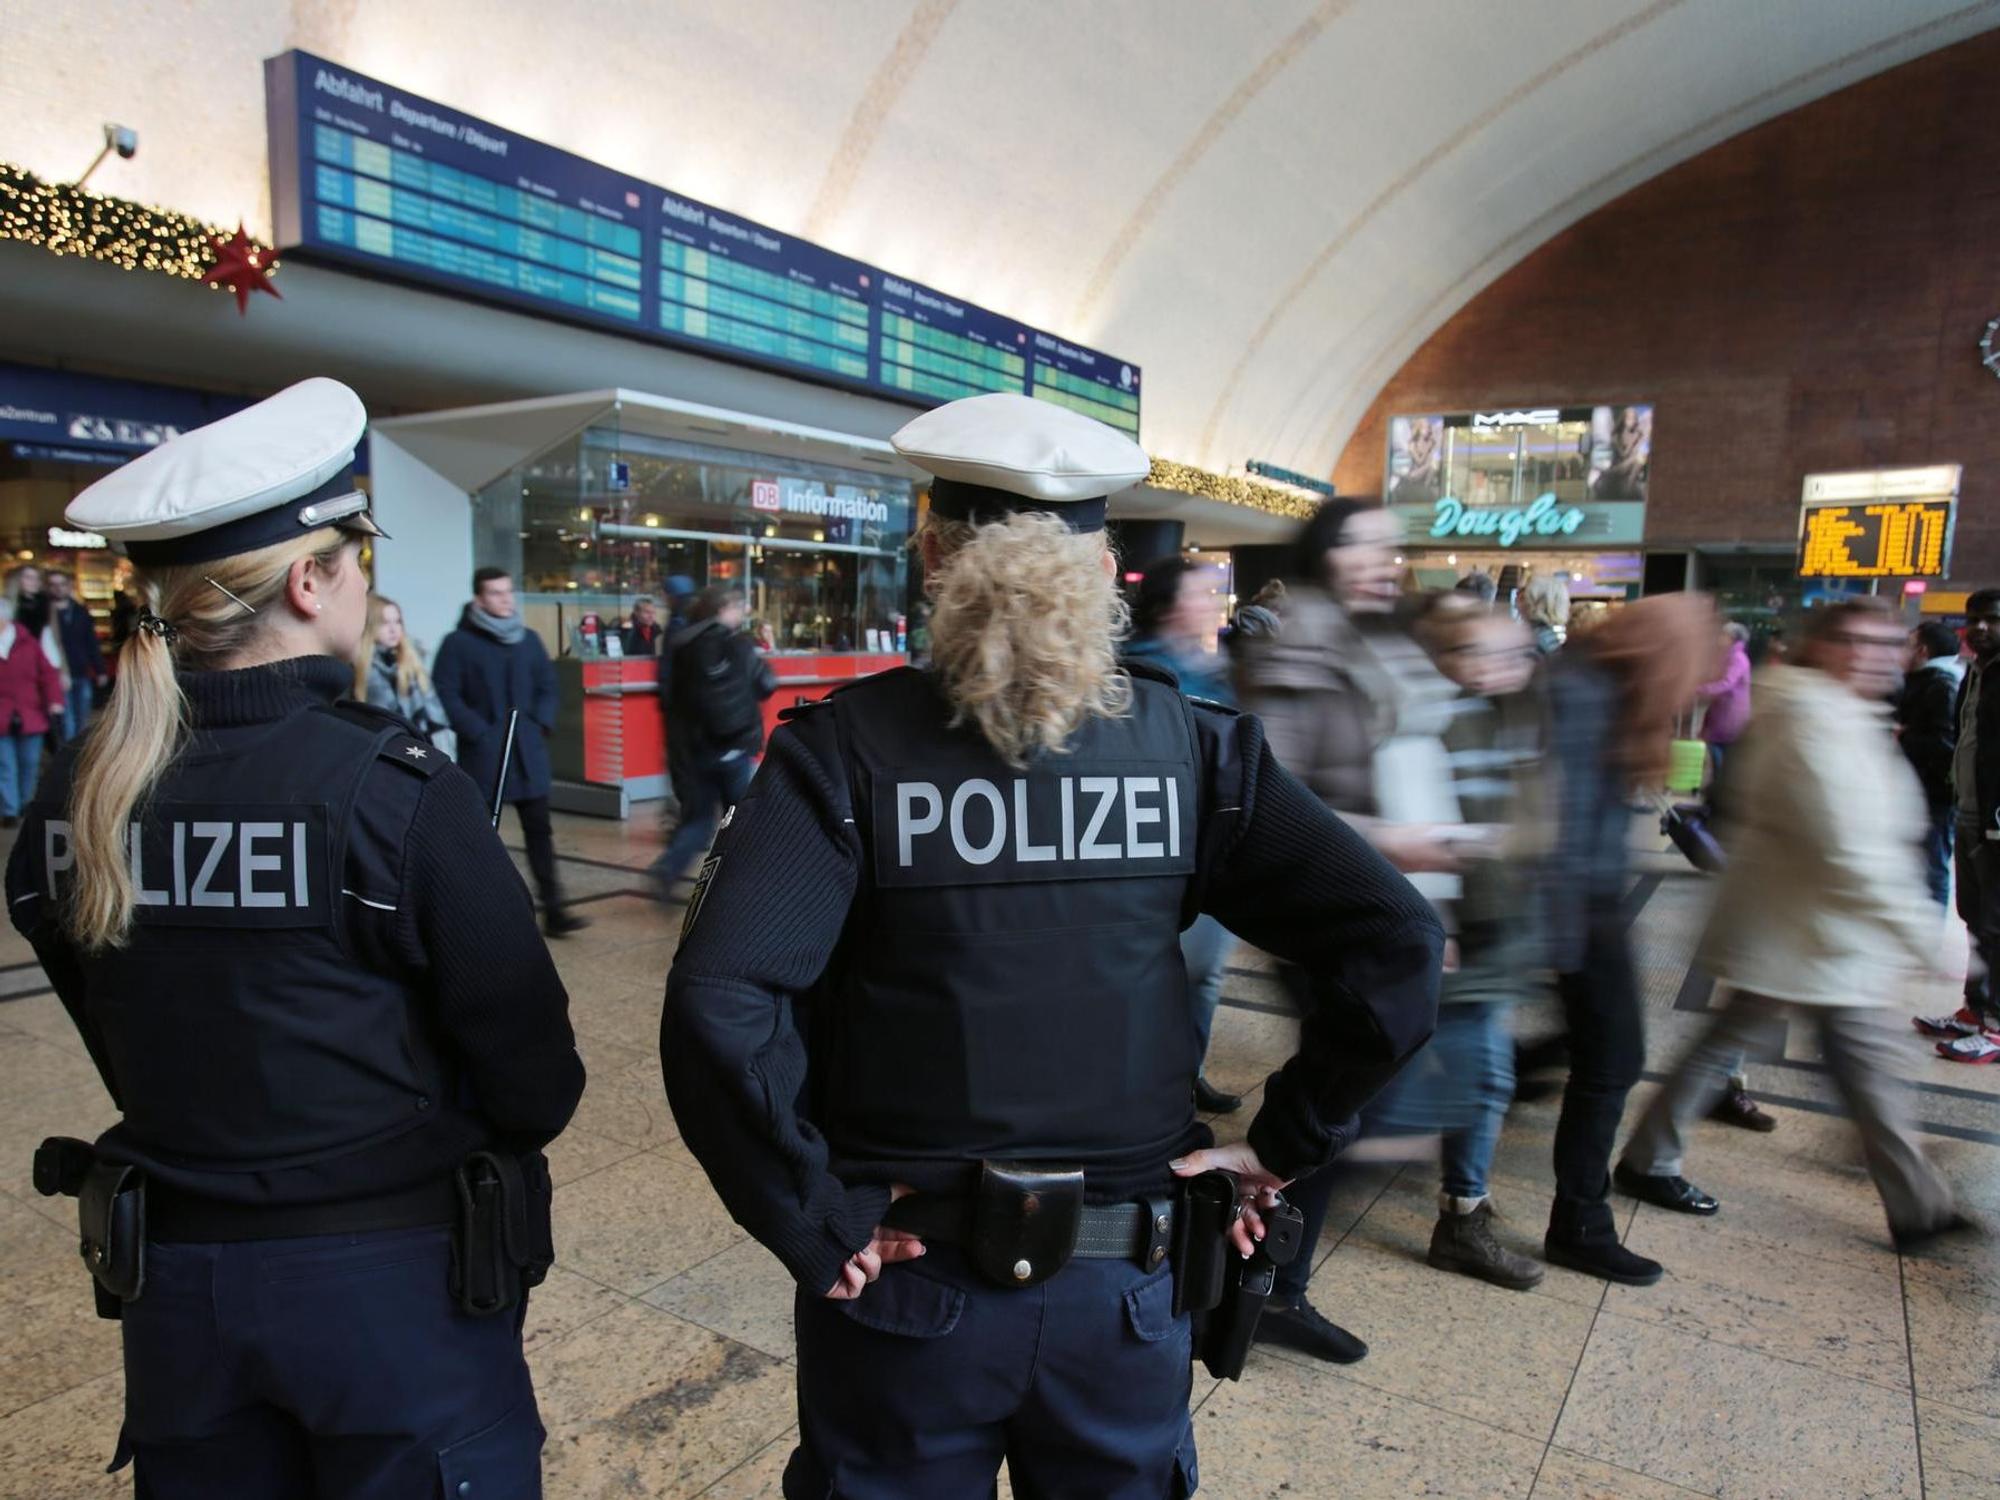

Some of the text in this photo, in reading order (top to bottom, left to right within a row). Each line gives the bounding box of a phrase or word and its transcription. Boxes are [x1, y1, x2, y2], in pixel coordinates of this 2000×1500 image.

[315, 69, 384, 112] Abfahrt
[754, 484, 888, 522] DB Information
[1430, 493, 1585, 546] Douglas
[897, 777, 1180, 866] POLIZEI
[45, 819, 309, 908] PLIZEI
